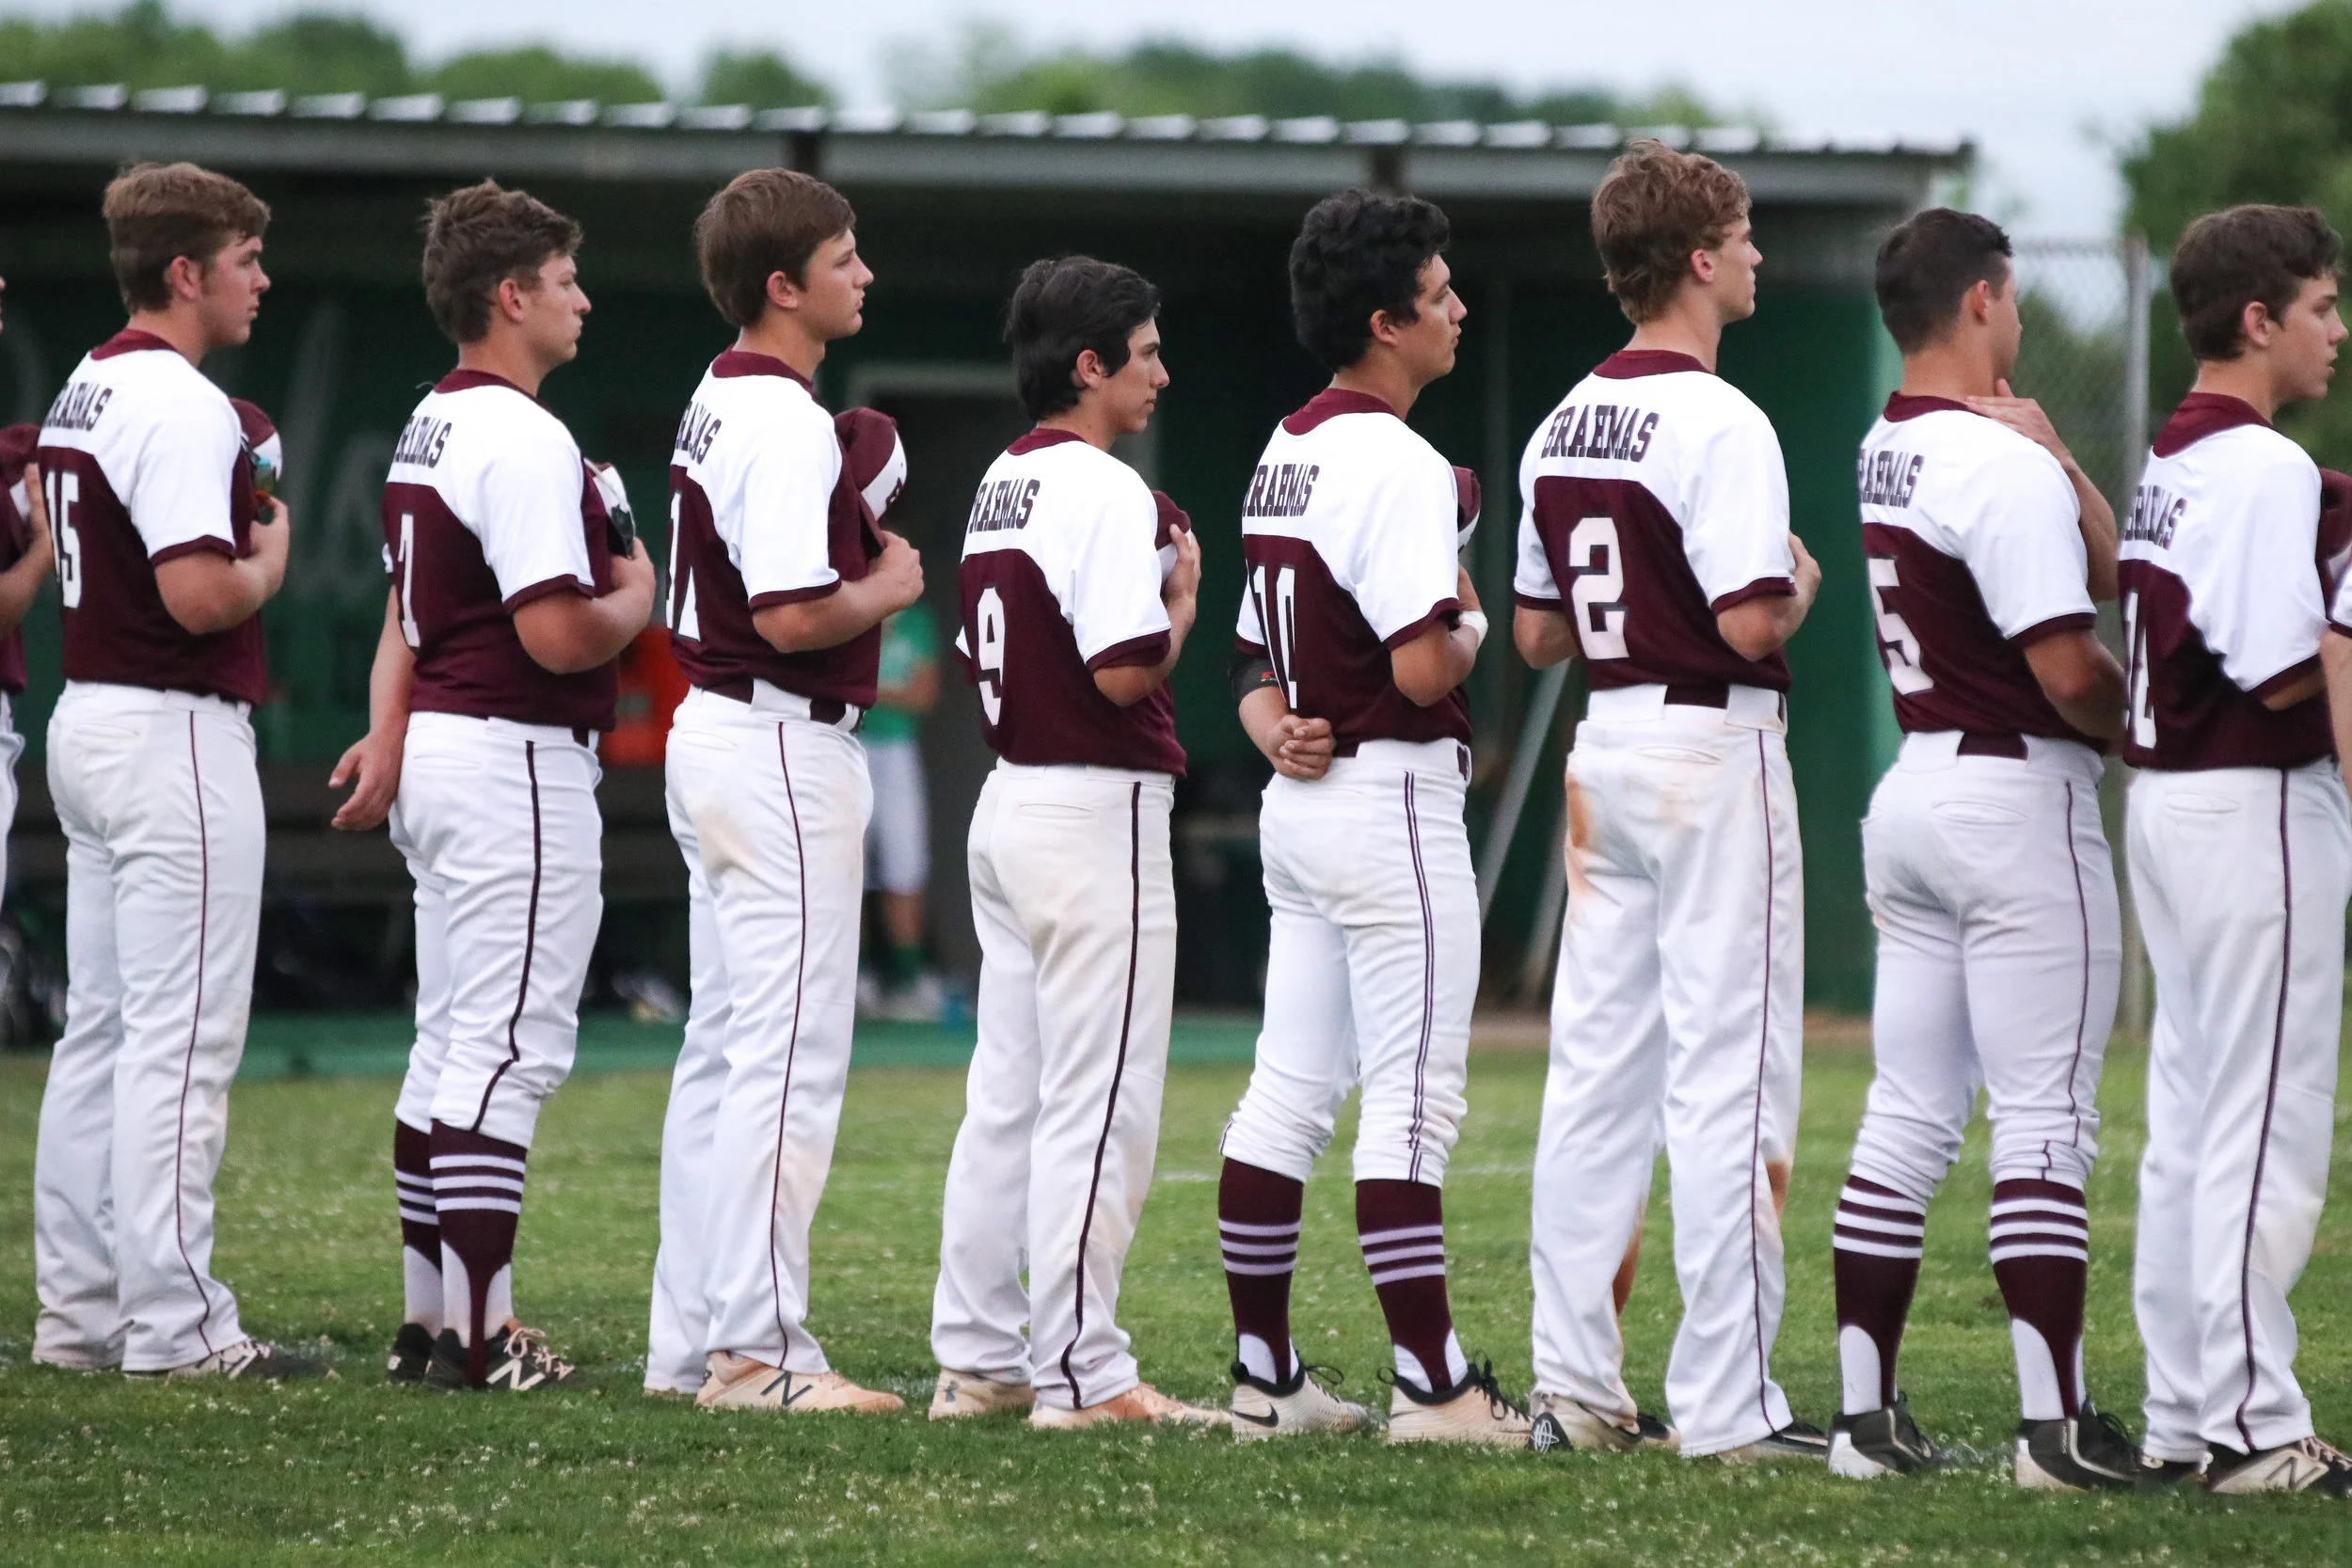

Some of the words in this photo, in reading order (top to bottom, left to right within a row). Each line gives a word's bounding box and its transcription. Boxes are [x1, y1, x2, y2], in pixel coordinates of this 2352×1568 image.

[46, 469, 82, 610] 15
[1569, 516, 1630, 660] 2
[977, 585, 1007, 726] 9
[1867, 557, 1934, 696] 5
